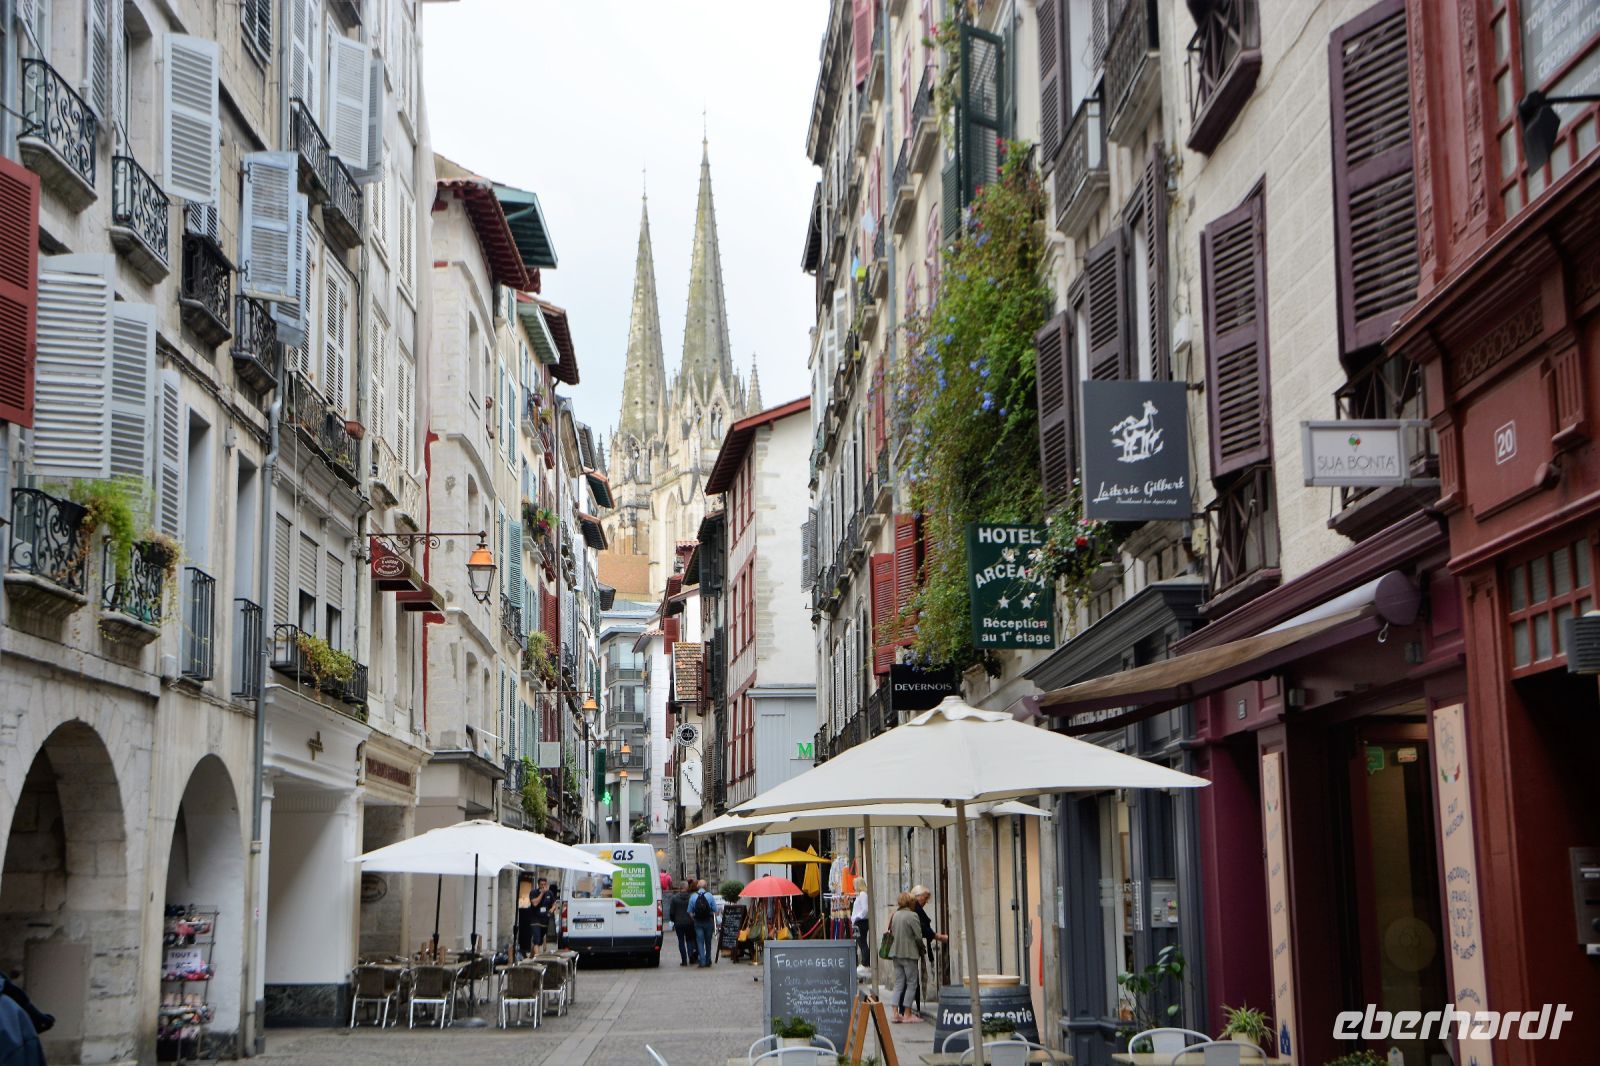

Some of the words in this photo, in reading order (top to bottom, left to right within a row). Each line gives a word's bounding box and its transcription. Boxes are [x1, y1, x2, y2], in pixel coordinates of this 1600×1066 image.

[1497, 429, 1513, 457] 20
[1317, 455, 1343, 471] SUA
[1092, 481, 1142, 503] Laiterie
[1144, 476, 1185, 498] Gilbert
[978, 527, 1042, 544] HOTEL
[983, 617, 1048, 630] Réception
[982, 633, 997, 642] au
[1015, 631, 1051, 645] étage
[895, 683, 952, 691] DEVERNOIS
[797, 742, 813, 759] M
[613, 850, 634, 861] GLS
[774, 953, 846, 969] FROMAGERIE
